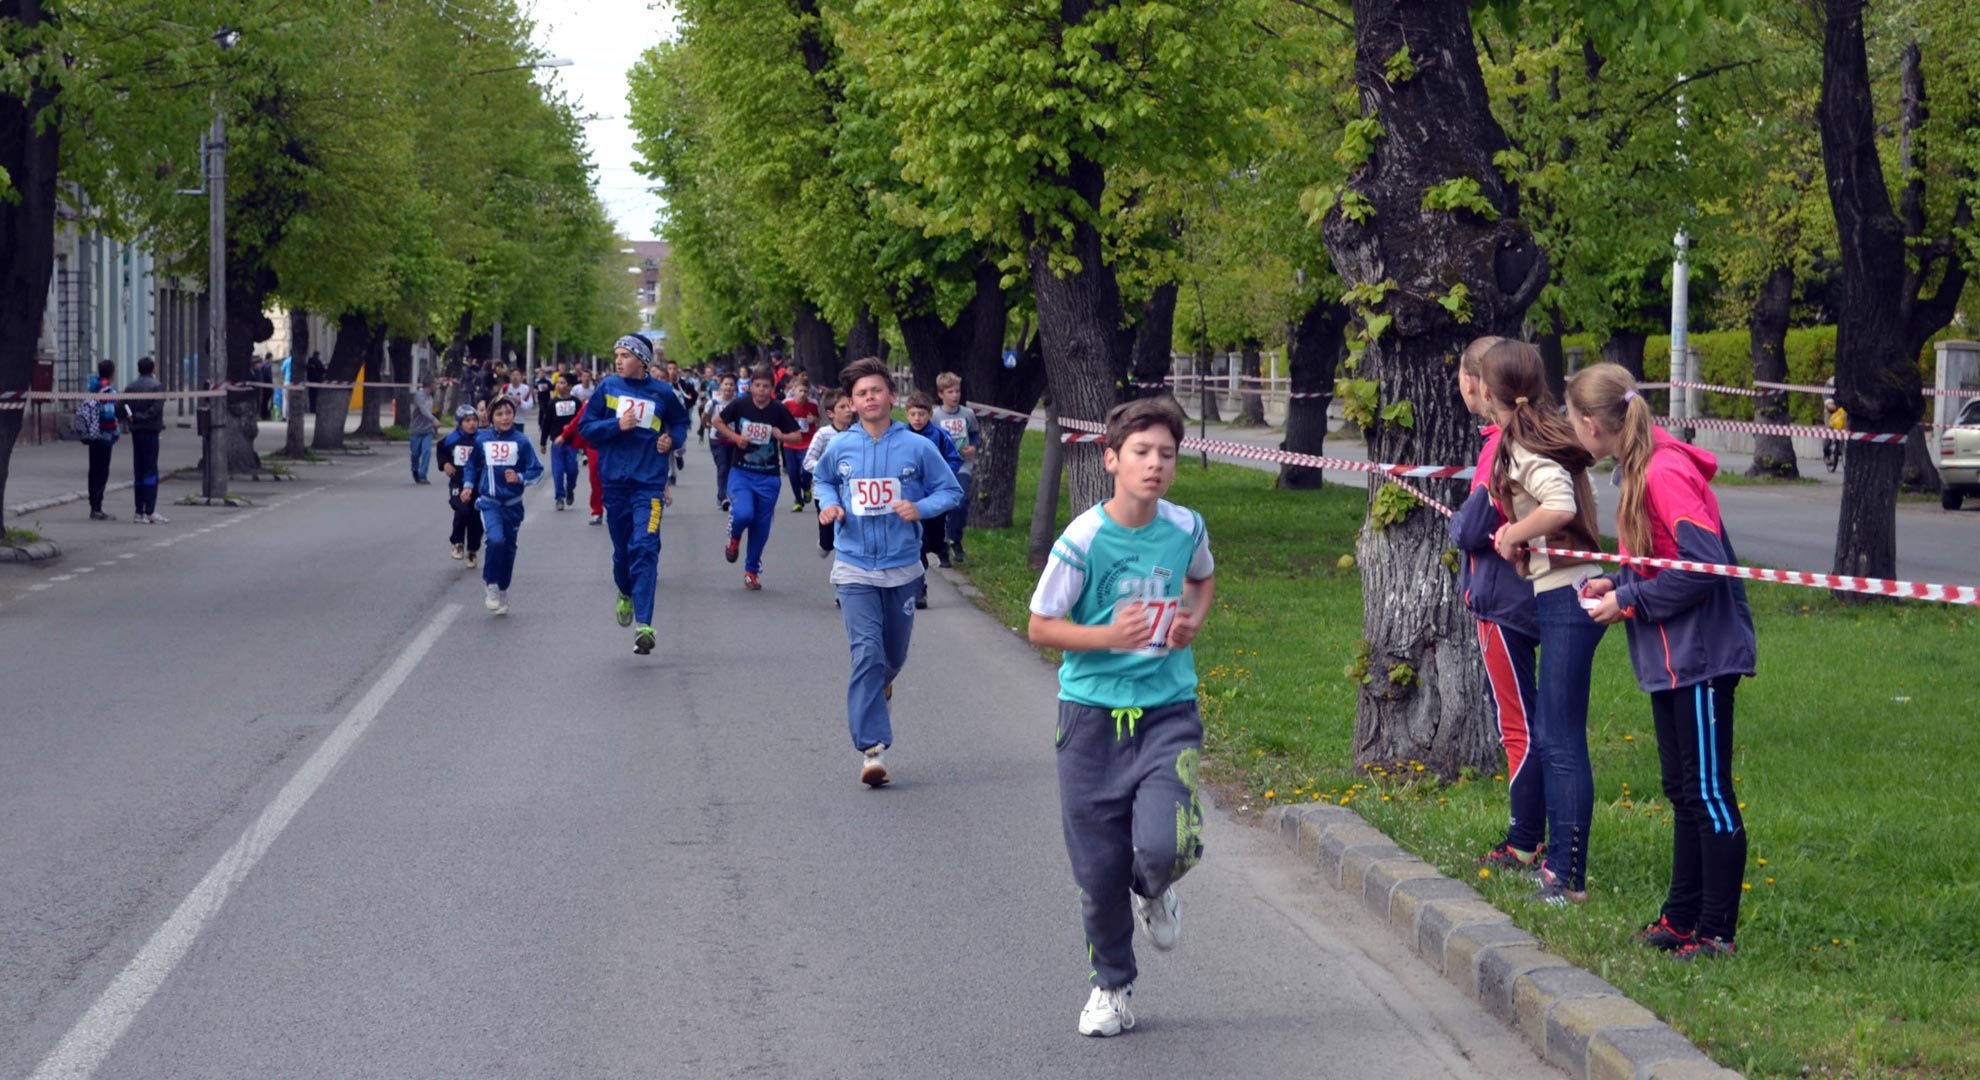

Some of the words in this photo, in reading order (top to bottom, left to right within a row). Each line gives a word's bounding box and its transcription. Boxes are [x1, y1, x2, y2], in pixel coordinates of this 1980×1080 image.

[747, 423, 768, 440] 988
[945, 419, 963, 433] 548
[491, 443, 510, 459] 39
[857, 480, 893, 505] 505
